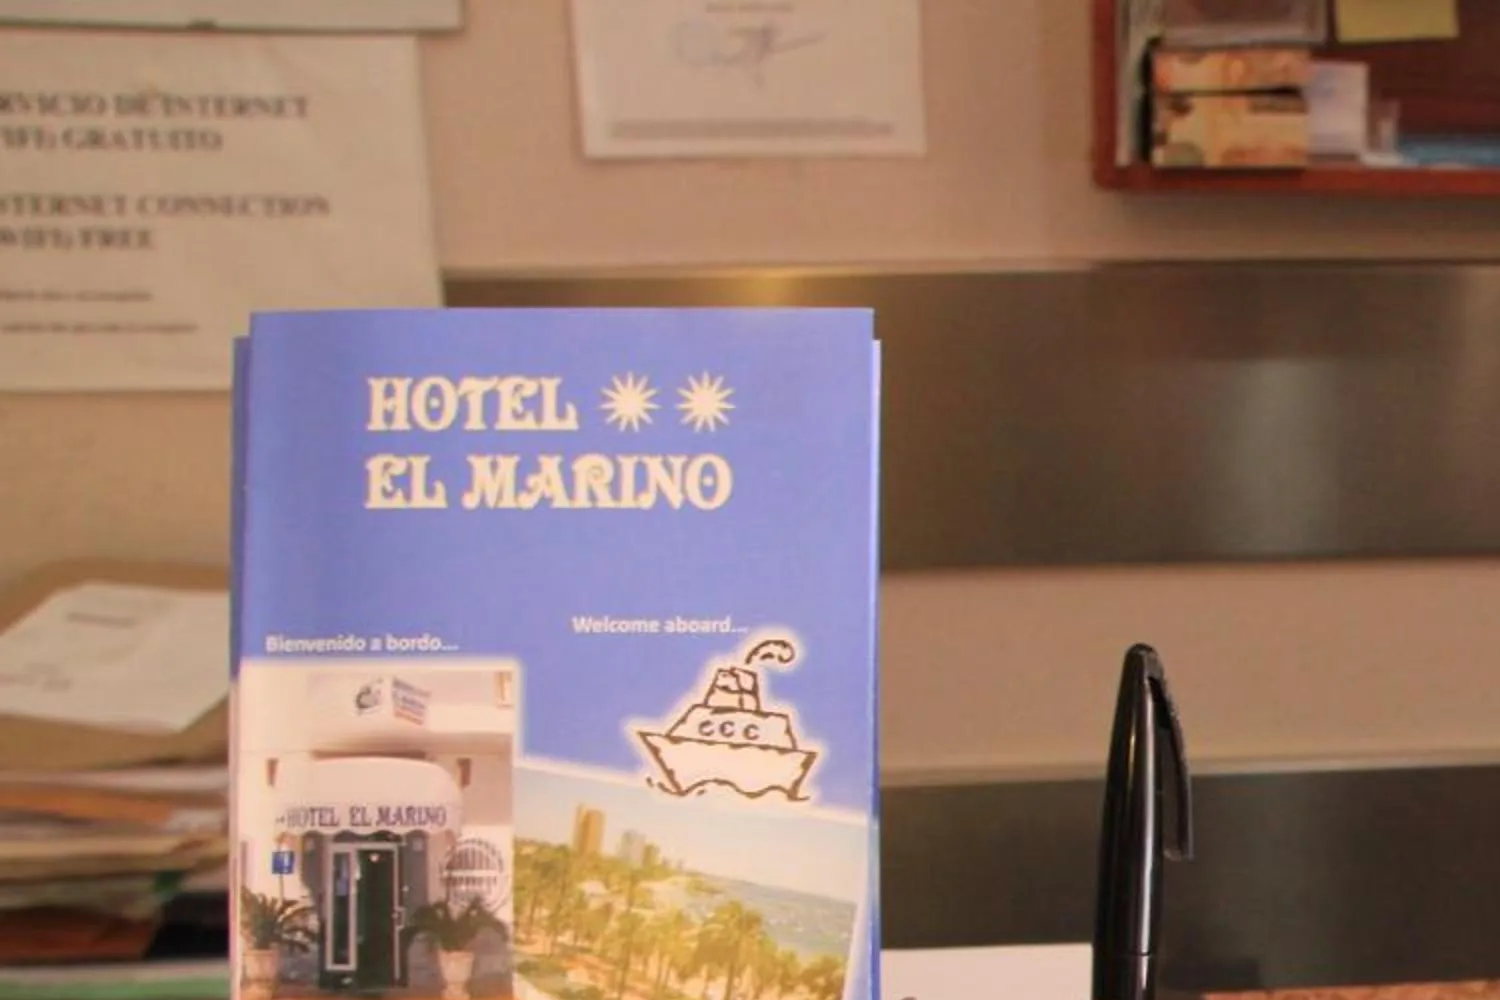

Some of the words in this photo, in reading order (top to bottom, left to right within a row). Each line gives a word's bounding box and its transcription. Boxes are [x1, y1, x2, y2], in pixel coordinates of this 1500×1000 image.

[159, 95, 308, 119] INTERNET
[61, 126, 224, 151] GRATUITO
[0, 195, 125, 218] TERNET
[366, 375, 579, 431] HOTEL
[364, 453, 448, 509] EL
[461, 453, 733, 510] MARINO
[572, 616, 660, 633] Welcome
[664, 616, 749, 634] aboard...
[266, 634, 366, 652] Bienvenido
[370, 637, 382, 650] a
[386, 633, 459, 650] bordo...
[350, 806, 371, 827] EL
[376, 806, 447, 827] MARINO
